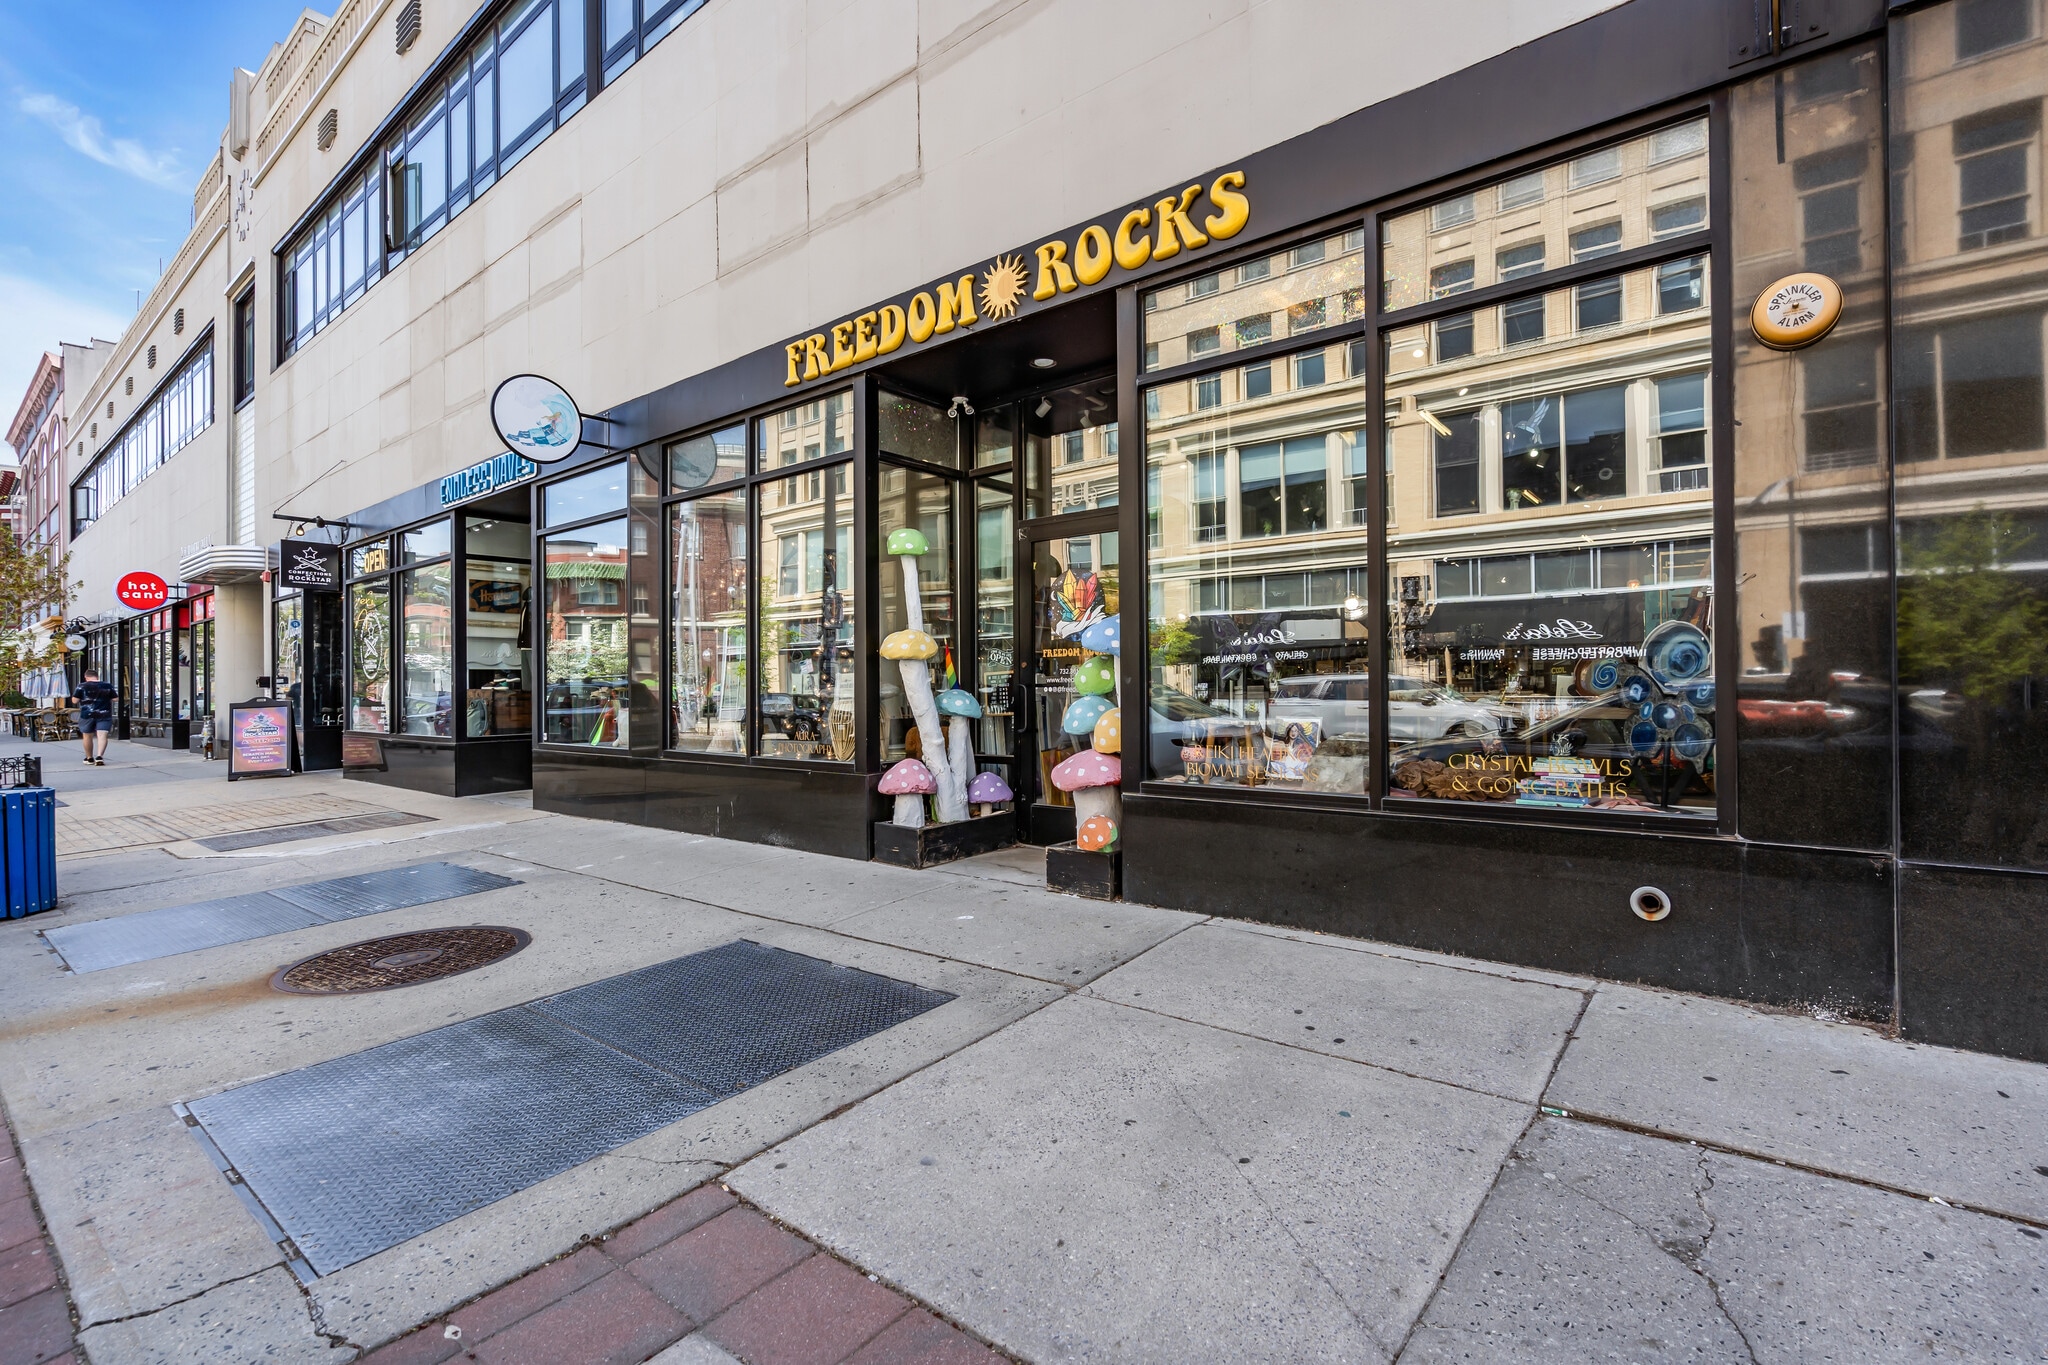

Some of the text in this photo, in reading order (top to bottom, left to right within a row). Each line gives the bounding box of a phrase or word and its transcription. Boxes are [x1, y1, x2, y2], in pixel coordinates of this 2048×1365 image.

[784, 170, 1250, 387] FREEDOM ROCKS
[1768, 284, 1822, 311] SPRINKLER
[1777, 311, 1816, 327] ALARM
[440, 452, 536, 506] ENDLESS WAVES
[365, 548, 386, 574] OPEN
[288, 569, 332, 577] CONFECTIONS
[288, 574, 332, 583] ROCKSTAR
[128, 581, 157, 591] hot
[121, 591, 164, 599] sand
[989, 653, 1012, 665] OPEN
[1042, 647, 1081, 658] FREEDOM
[794, 731, 816, 741] AURA
[778, 743, 834, 754] PHOTOGRAPHY
[1195, 744, 1233, 760] REIKI
[1187, 762, 1320, 782] BIOMAT SESSIONS
[1448, 753, 1632, 777] CRYSTAL BOWLS
[1452, 775, 1468, 792] &
[1477, 776, 1548, 795] GONG
[1555, 782, 1627, 800] BATHS
